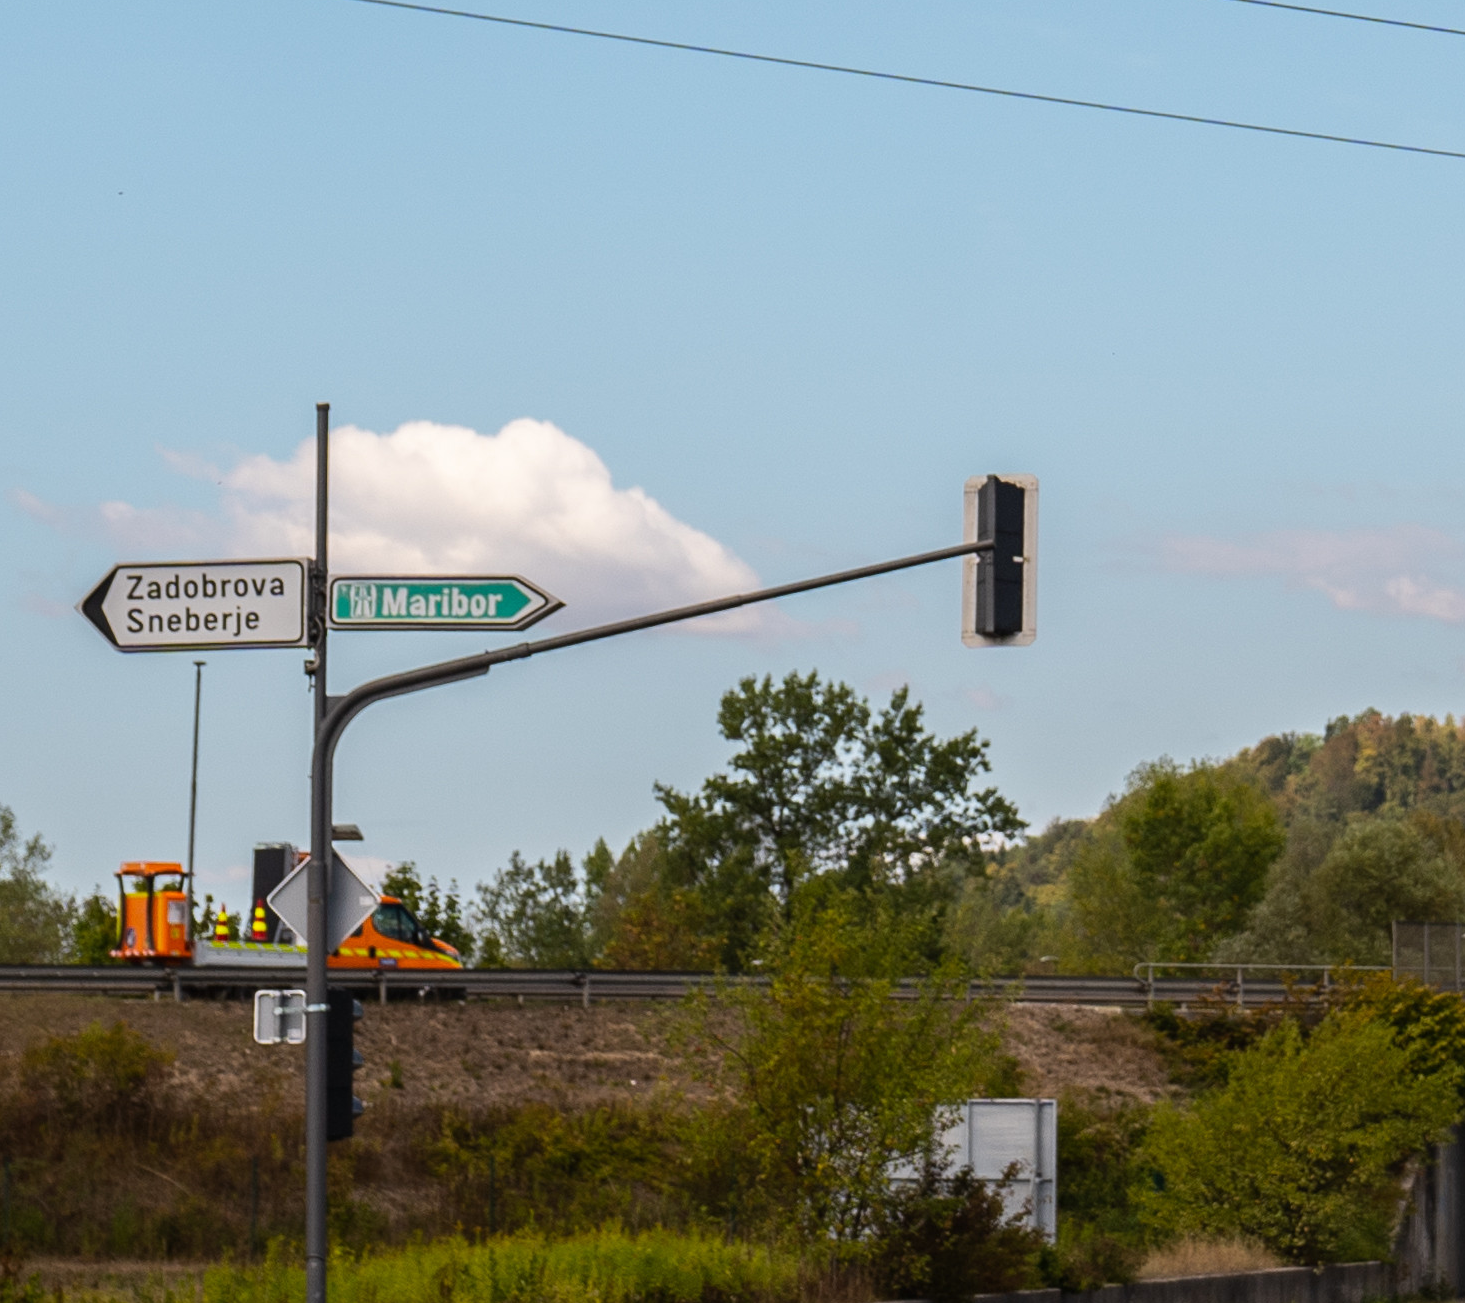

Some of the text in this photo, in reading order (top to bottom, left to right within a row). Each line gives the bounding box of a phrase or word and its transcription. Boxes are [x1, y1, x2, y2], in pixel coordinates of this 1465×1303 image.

[126, 573, 286, 601] Zadobrova
[381, 587, 503, 617] Maribor
[126, 607, 261, 637] Sneberje
